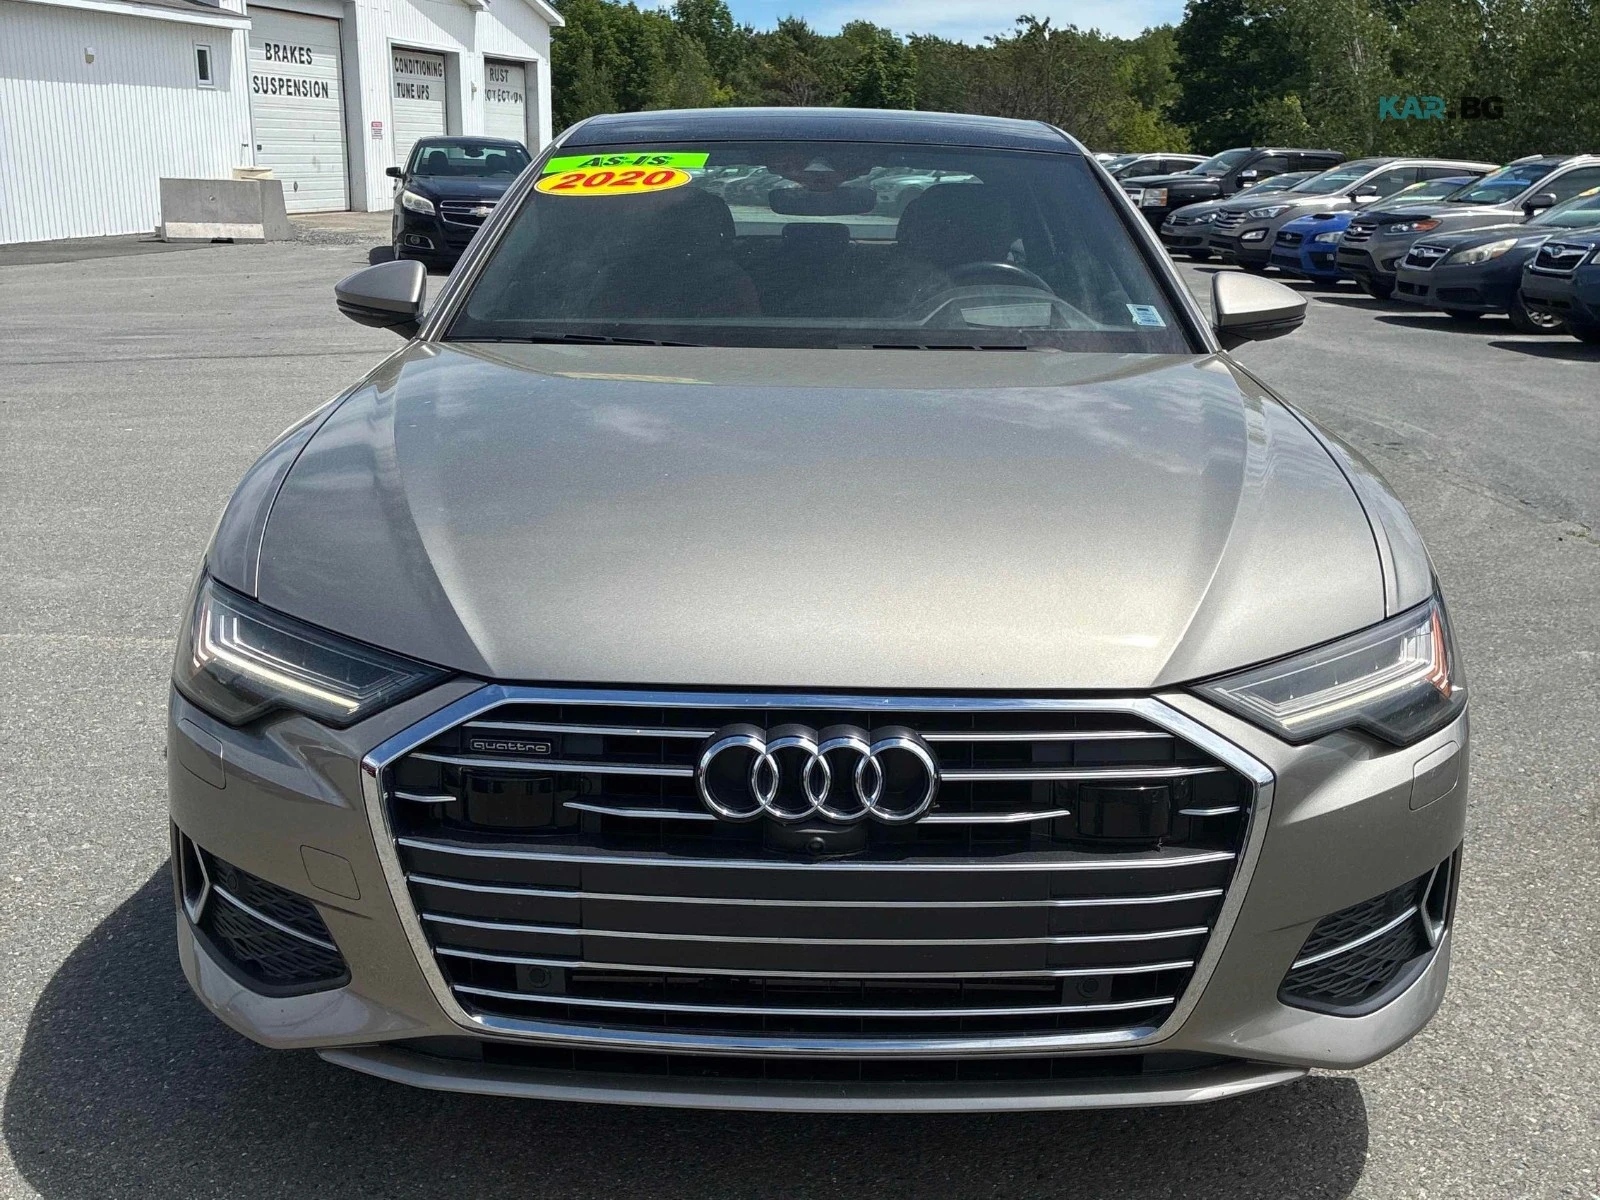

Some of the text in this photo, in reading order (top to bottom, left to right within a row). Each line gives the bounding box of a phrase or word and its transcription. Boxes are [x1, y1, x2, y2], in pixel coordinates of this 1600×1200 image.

[265, 43, 312, 65] BRAKES
[395, 57, 442, 77] CONDITIONING
[490, 68, 508, 82] RUST
[253, 75, 328, 98] SUSPENSION
[397, 82, 429, 100] TUNE UPS
[578, 155, 671, 168] AS-IS
[550, 170, 676, 190] 2020
[474, 742, 547, 752] quattro
